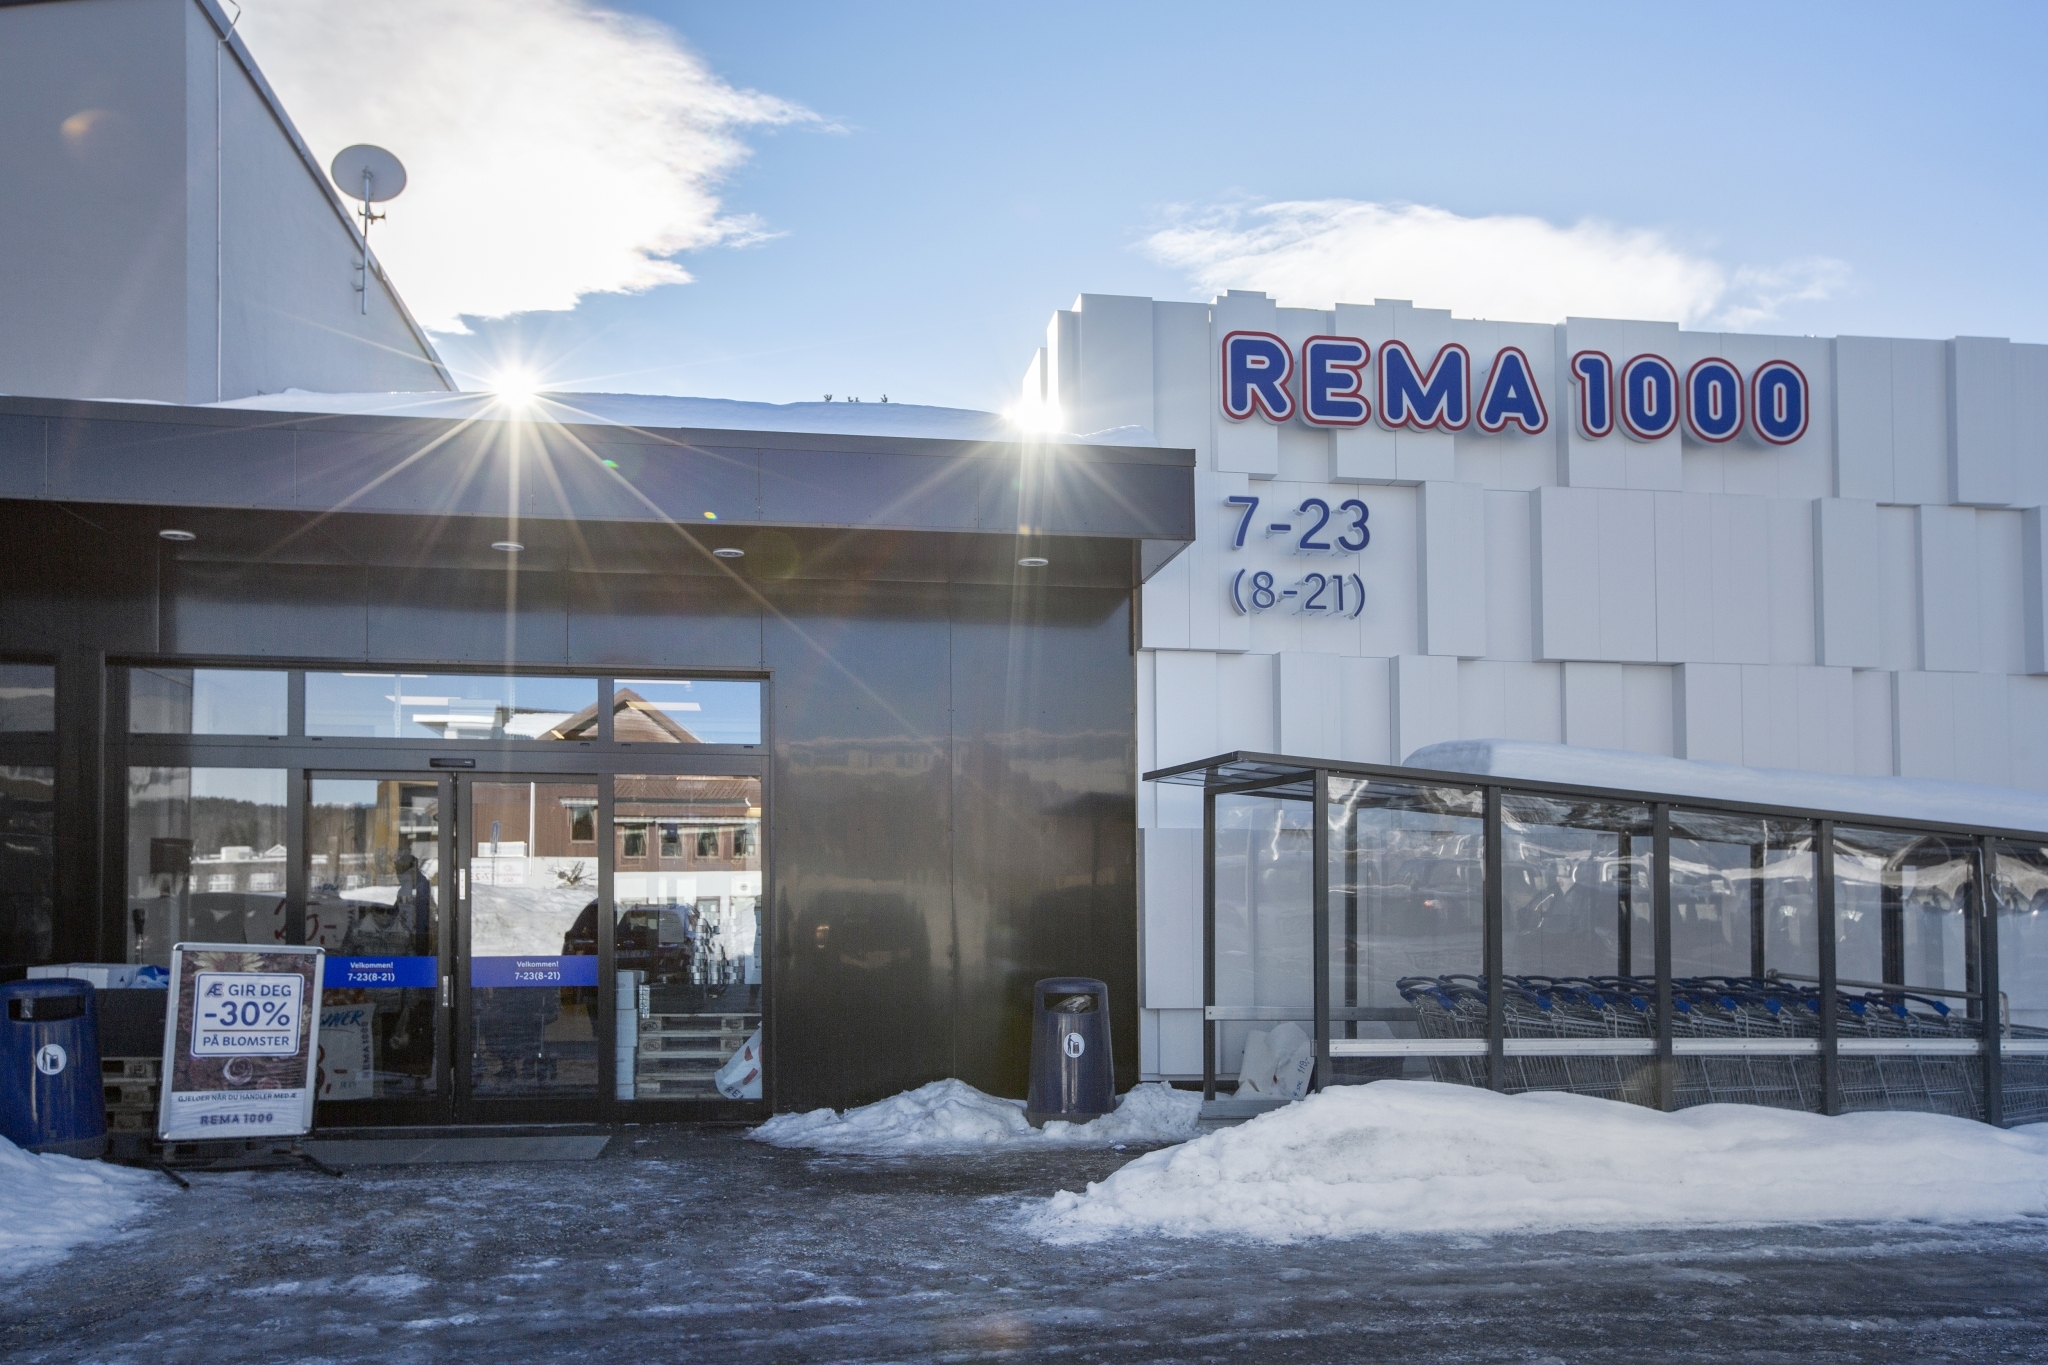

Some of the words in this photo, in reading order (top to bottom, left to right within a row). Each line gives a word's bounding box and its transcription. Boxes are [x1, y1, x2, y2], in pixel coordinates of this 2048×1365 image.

[1221, 330, 1548, 435] REMA
[1569, 350, 1809, 446] 1000
[1225, 495, 1371, 553] 7-23
[1231, 568, 1365, 618] (8-21)
[350, 961, 394, 970] Velkommen!
[516, 960, 559, 969] Velkommen!
[347, 972, 395, 983] 7-23(8-21)
[514, 971, 561, 982] 7-23(8-21)
[204, 981, 225, 998] Æ
[229, 985, 256, 997] GIR
[261, 985, 291, 997] DEG
[205, 1001, 290, 1027] -30%
[203, 1034, 220, 1046] PÅ
[223, 1036, 290, 1047] BLOMSTER
[211, 1093, 227, 1102] NÅR
[240, 1093, 272, 1101] HANDLER
[199, 1114, 240, 1126] REMA
[243, 1113, 273, 1124] 1000
